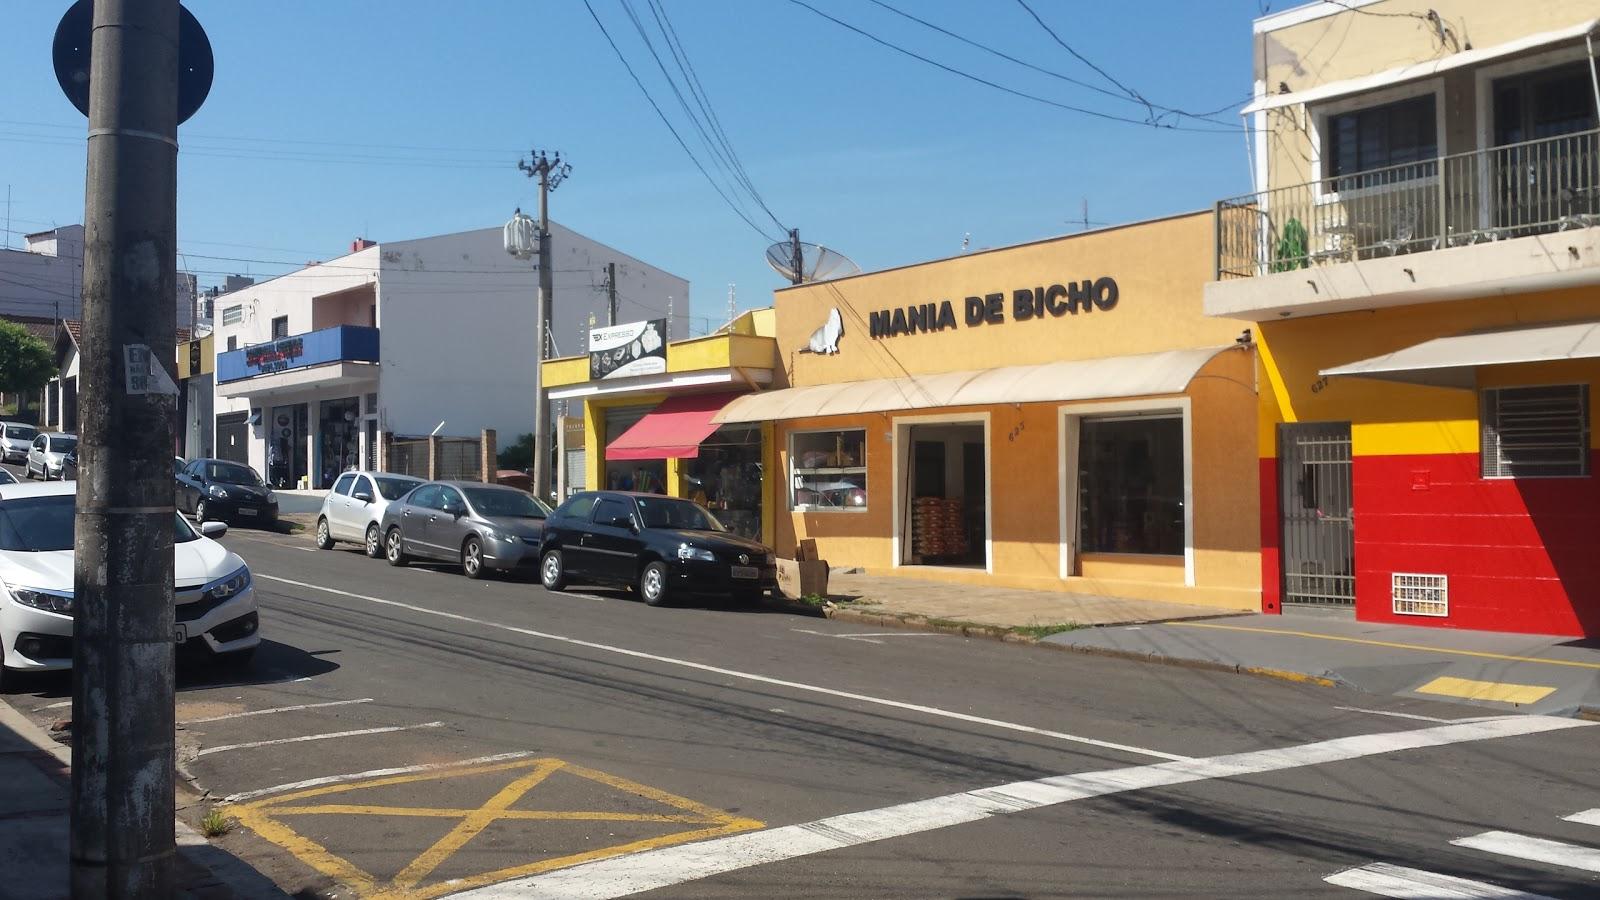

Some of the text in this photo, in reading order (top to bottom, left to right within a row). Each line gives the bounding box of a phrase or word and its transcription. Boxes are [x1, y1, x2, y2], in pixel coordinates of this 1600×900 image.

[869, 277, 1119, 340] MANIA DE BICHO
